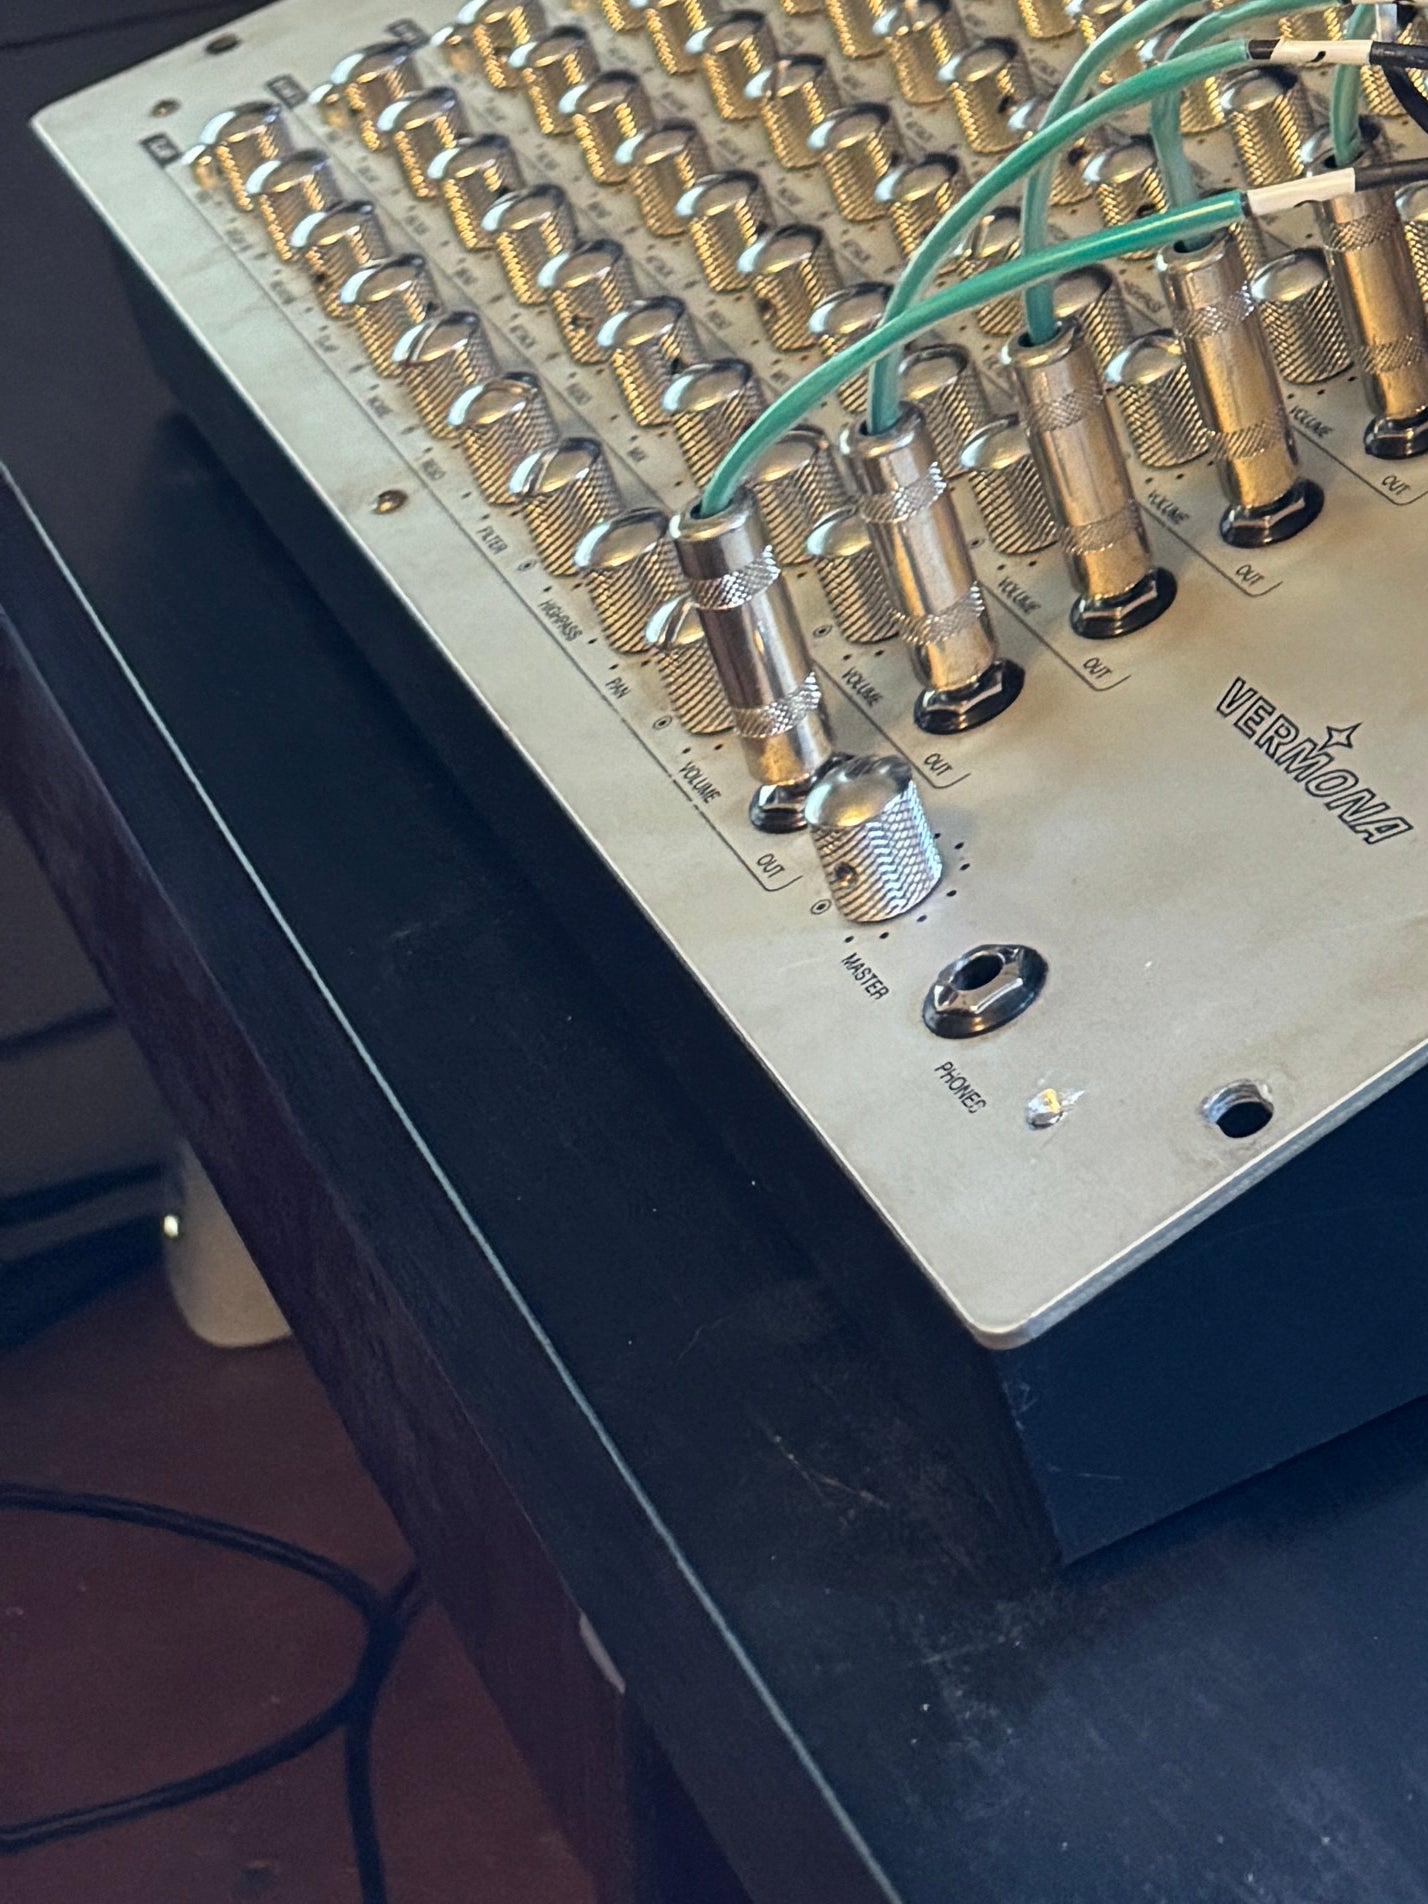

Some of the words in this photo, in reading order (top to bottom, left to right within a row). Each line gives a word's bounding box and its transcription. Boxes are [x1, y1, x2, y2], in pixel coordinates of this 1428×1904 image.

[1289, 404, 1335, 438] VOLUME
[1381, 474, 1411, 496] OUT
[1147, 490, 1190, 526] VOLUME
[1234, 563, 1265, 586] OUT
[998, 576, 1041, 615] VOLUME
[1082, 656, 1113, 679] OUT
[604, 676, 632, 701] PAN
[841, 666, 883, 708] VOLUME
[923, 752, 953, 777] OUT
[1215, 675, 1414, 845] VERMONA
[678, 760, 722, 804] VOLUME
[755, 852, 787, 880] OUT
[840, 951, 891, 1001] MASTER
[933, 1060, 988, 1115] PHONES
